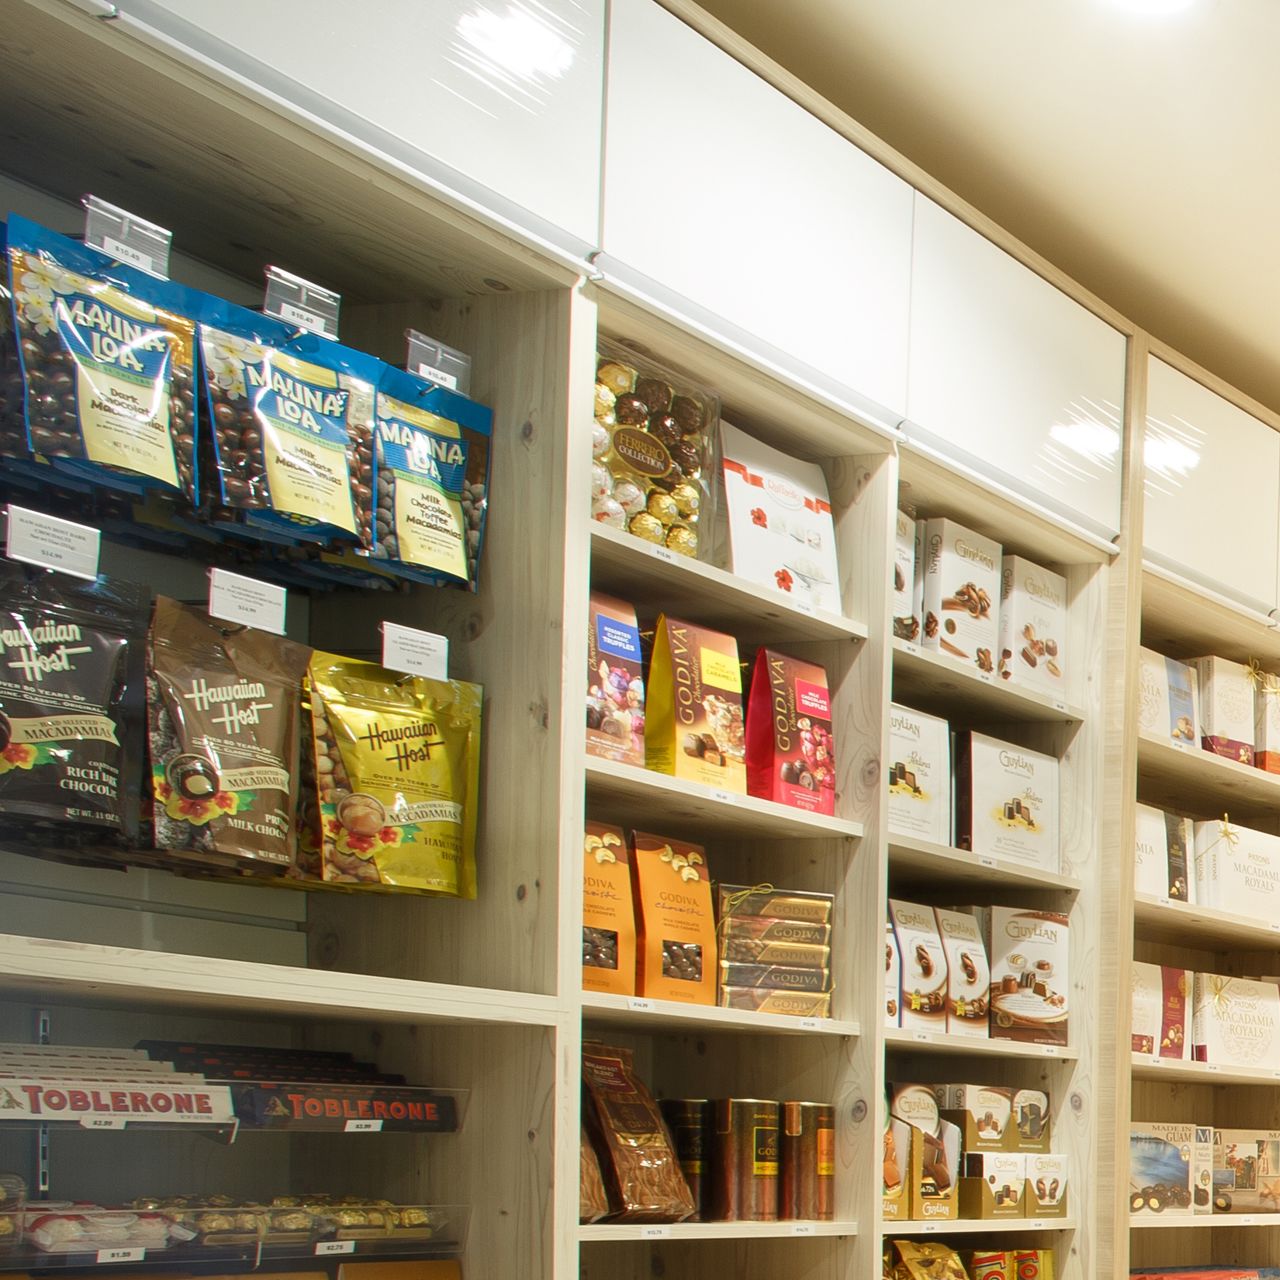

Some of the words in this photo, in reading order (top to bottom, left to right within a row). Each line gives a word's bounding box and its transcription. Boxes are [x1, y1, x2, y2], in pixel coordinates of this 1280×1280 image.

[55, 297, 165, 353] MAUNA
[93, 332, 144, 373] LOA
[247, 366, 343, 417] MAUNA
[277, 397, 322, 433] LOA
[619, 432, 665, 462] FERRERO
[619, 445, 666, 471] COLLECTION
[421, 493, 441, 505] Milk
[677, 626, 689, 725] GODIVA
[184, 678, 266, 711] Hawaiian
[777, 659, 790, 752] GODIVA
[212, 702, 273, 734] Host
[359, 719, 438, 751] Hawaiian
[386, 741, 445, 771] Host
[1244, 876, 1276, 894] ROYALS
[1214, 1008, 1276, 1029] MACADAMIA
[22, 1085, 213, 1114] TOBLERONE
[288, 1093, 440, 1121] TOBLERONE
[1166, 1131, 1192, 1143] GUAM
